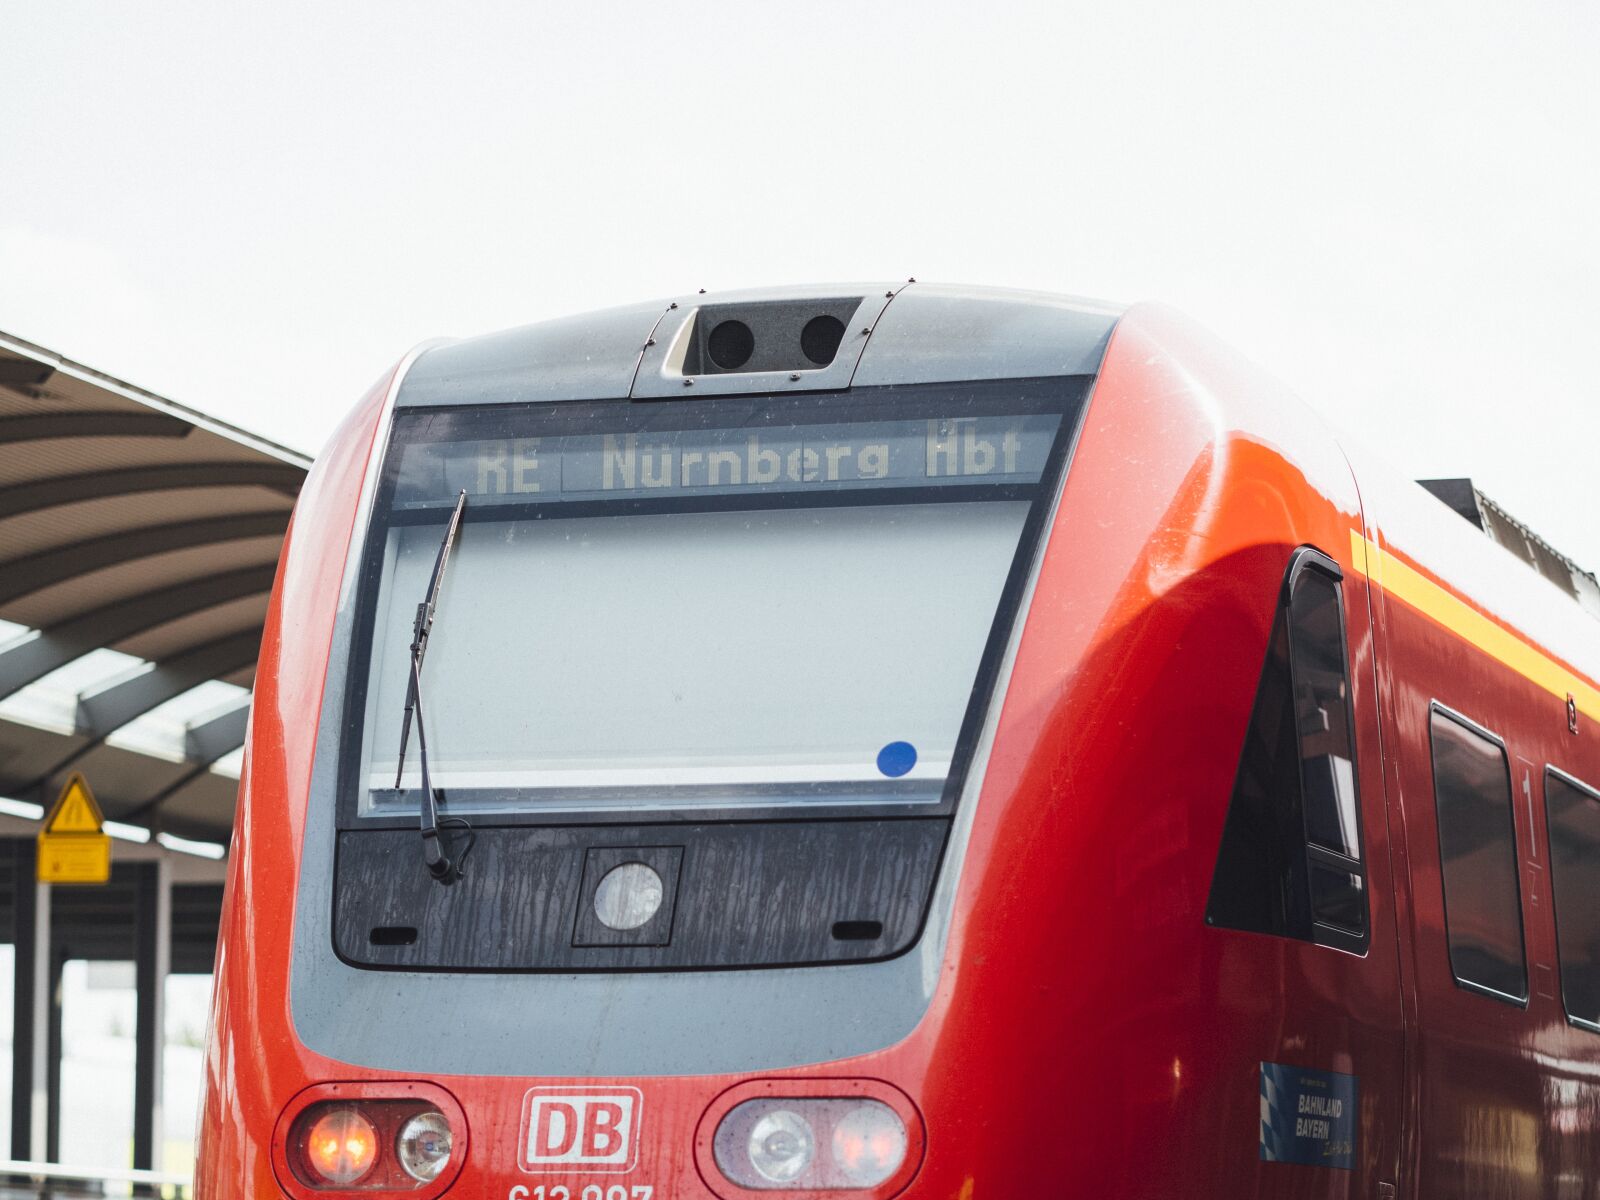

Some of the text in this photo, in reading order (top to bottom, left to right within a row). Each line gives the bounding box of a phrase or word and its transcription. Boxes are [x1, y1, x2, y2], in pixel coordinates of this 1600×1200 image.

[477, 418, 1024, 495] RE Nürnberg Hbf
[1298, 1094, 1343, 1119] BAHNLAND
[533, 1100, 625, 1158] DB
[1295, 1117, 1330, 1140] BAYERN
